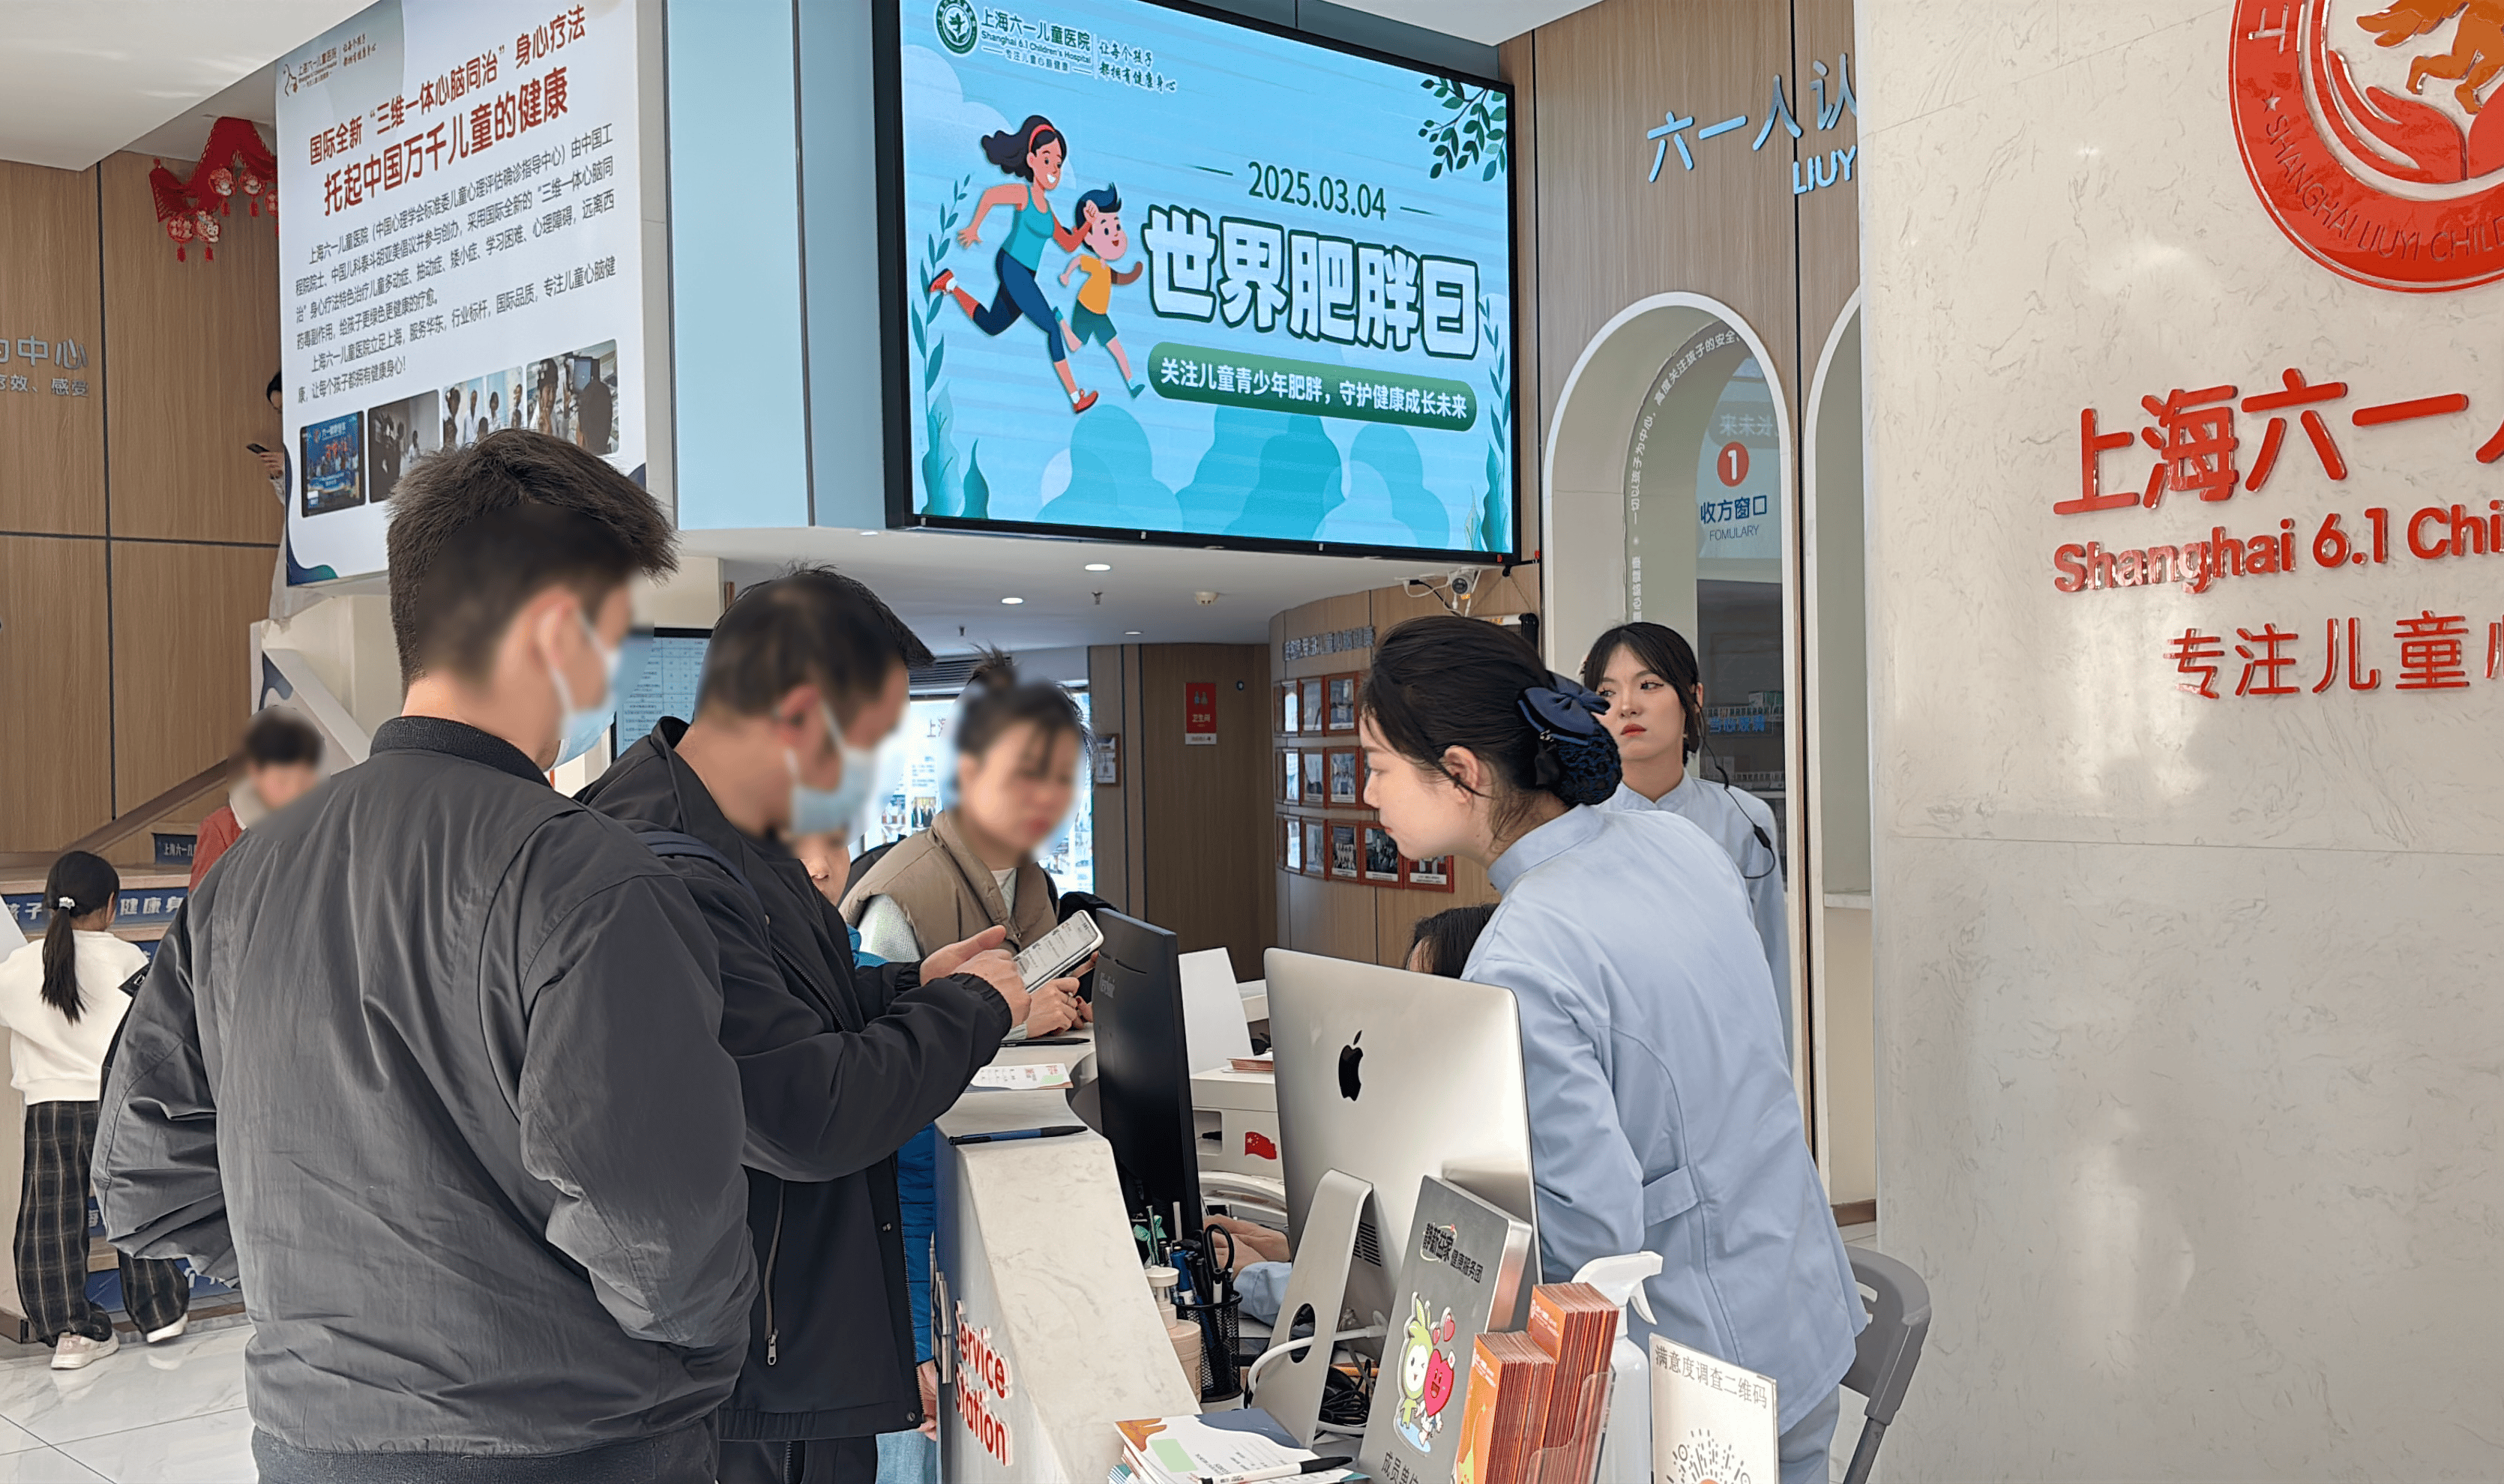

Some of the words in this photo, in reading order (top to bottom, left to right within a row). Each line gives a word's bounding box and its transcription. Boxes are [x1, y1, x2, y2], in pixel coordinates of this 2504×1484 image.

[981, 8, 1091, 51] 上海六一儿童医院
[981, 31, 1016, 46] Shanghai
[1064, 50, 1092, 64] Hospital
[325, 67, 568, 216] 托起中国万千儿童的健康
[1793, 145, 1856, 195] LIUY
[1248, 161, 1387, 221] 2025.03.04
[2266, 115, 2358, 241] SHANGHAI
[1142, 203, 1482, 360] 世界肥胖日
[1161, 358, 1467, 420] 关注儿童青少年肥胖，守护健康成长未来
[1727, 450, 1738, 480] 1
[1700, 495, 1767, 525] 收方窗口
[1709, 525, 1760, 540] FOMULARY
[2054, 519, 2296, 594] Shanghai
[2313, 507, 2389, 568] 6.1
[2407, 500, 2504, 559] Chi
[163, 842, 196, 857] 上海六一儿
[955, 1300, 1009, 1399] Service
[1654, 1343, 1768, 1410] 满意度调查二维码
[955, 1363, 1010, 1467] Station
